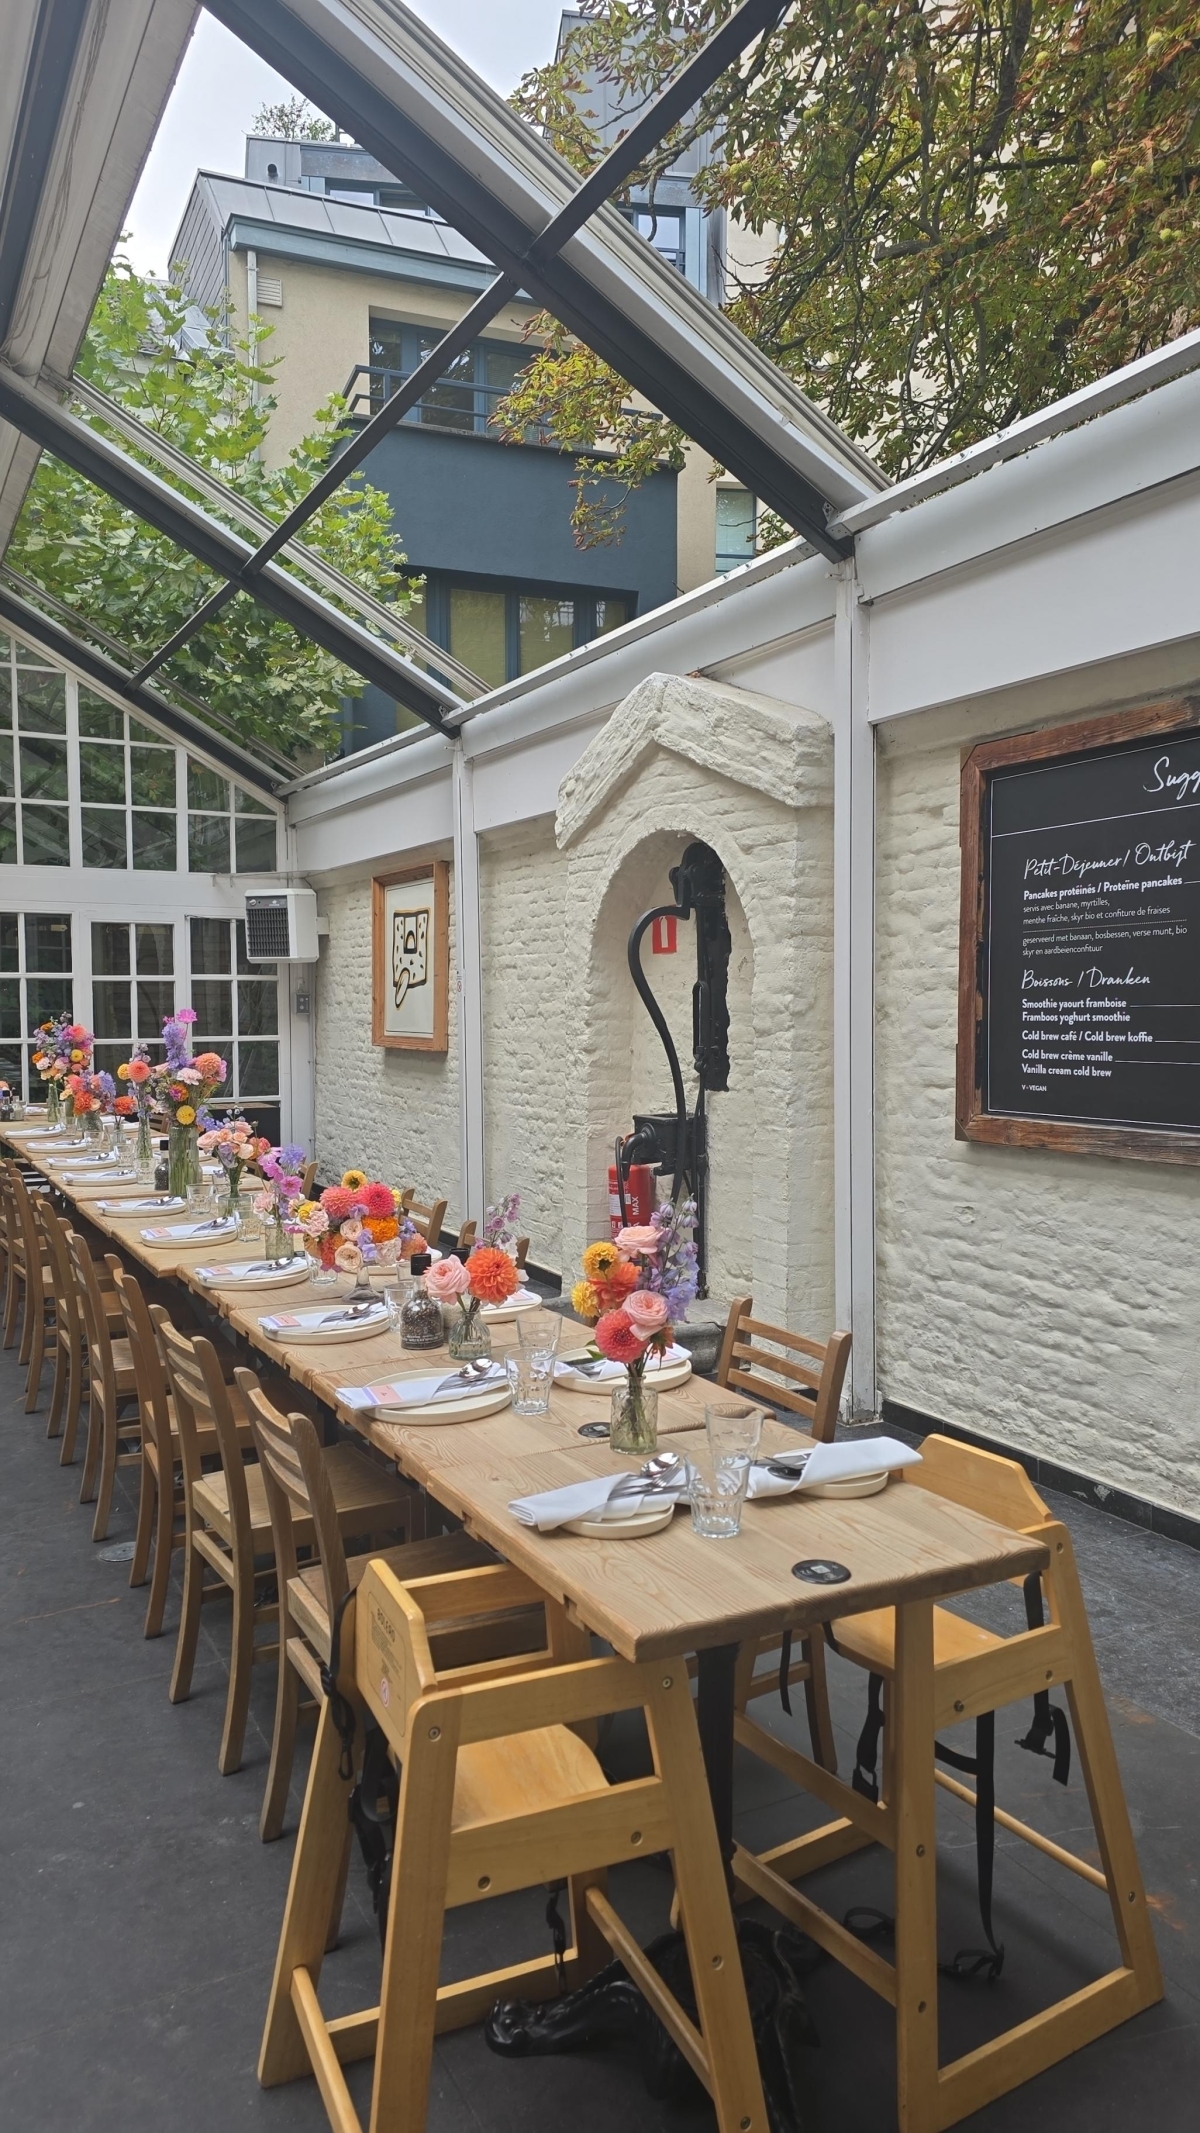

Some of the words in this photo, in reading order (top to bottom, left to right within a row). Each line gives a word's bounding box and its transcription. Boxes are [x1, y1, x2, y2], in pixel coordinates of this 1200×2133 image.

[1024, 854, 1122, 879] Petit-Déjeuner
[1135, 840, 1197, 868] Ontbijt
[1023, 888, 1057, 900] Pancakes
[1059, 883, 1096, 900] protéinés
[1097, 882, 1101, 893] /
[1103, 880, 1139, 892] Proteïne
[1141, 875, 1182, 892] pancakes
[1023, 904, 1039, 913] servis
[1055, 901, 1080, 910] banane,
[1081, 897, 1110, 910] myrtilles,
[1023, 916, 1046, 925] menthe
[1047, 914, 1070, 924] fraîche,
[1071, 913, 1084, 923] skyr
[1085, 912, 1095, 920] bio
[1105, 909, 1136, 918] confiture
[1137, 907, 1146, 916] de
[1147, 906, 1170, 915] fraises
[1022, 934, 1054, 946] geserveerd
[1056, 934, 1068, 942] met
[1070, 932, 1094, 941] banaan,
[1095, 930, 1131, 939] bosbessen,
[1153, 927, 1174, 936] munt,
[1176, 925, 1187, 934] bio
[1023, 947, 1035, 958] skyr
[1044, 944, 1103, 955] aardbeienconfituur
[1021, 969, 1073, 989] Boissons
[1077, 971, 1084, 988] /
[1086, 966, 1150, 988] Dranken
[1022, 998, 1057, 1008] Smoothie
[1059, 999, 1084, 1011] yaourt
[1085, 997, 1127, 1007] framboise
[1022, 1012, 1058, 1021] Framboos
[1059, 1012, 1091, 1025] yoghurt
[1092, 1011, 1130, 1021] smoothie
[1022, 1030, 1039, 1040] Cold
[1041, 1031, 1059, 1040] brew
[1061, 1031, 1077, 1041] café
[1085, 1031, 1103, 1042] Cold
[1105, 1031, 1126, 1042] brew
[1128, 1031, 1153, 1042] koffie
[1022, 1049, 1039, 1059] Cold
[1041, 1049, 1059, 1060] brew
[1061, 1051, 1085, 1061] crème
[1086, 1051, 1113, 1062] vanille
[1022, 1064, 1047, 1074] Vanilla
[1048, 1067, 1072, 1076] cream
[1073, 1066, 1090, 1076] cold
[1091, 1066, 1112, 1077] brew
